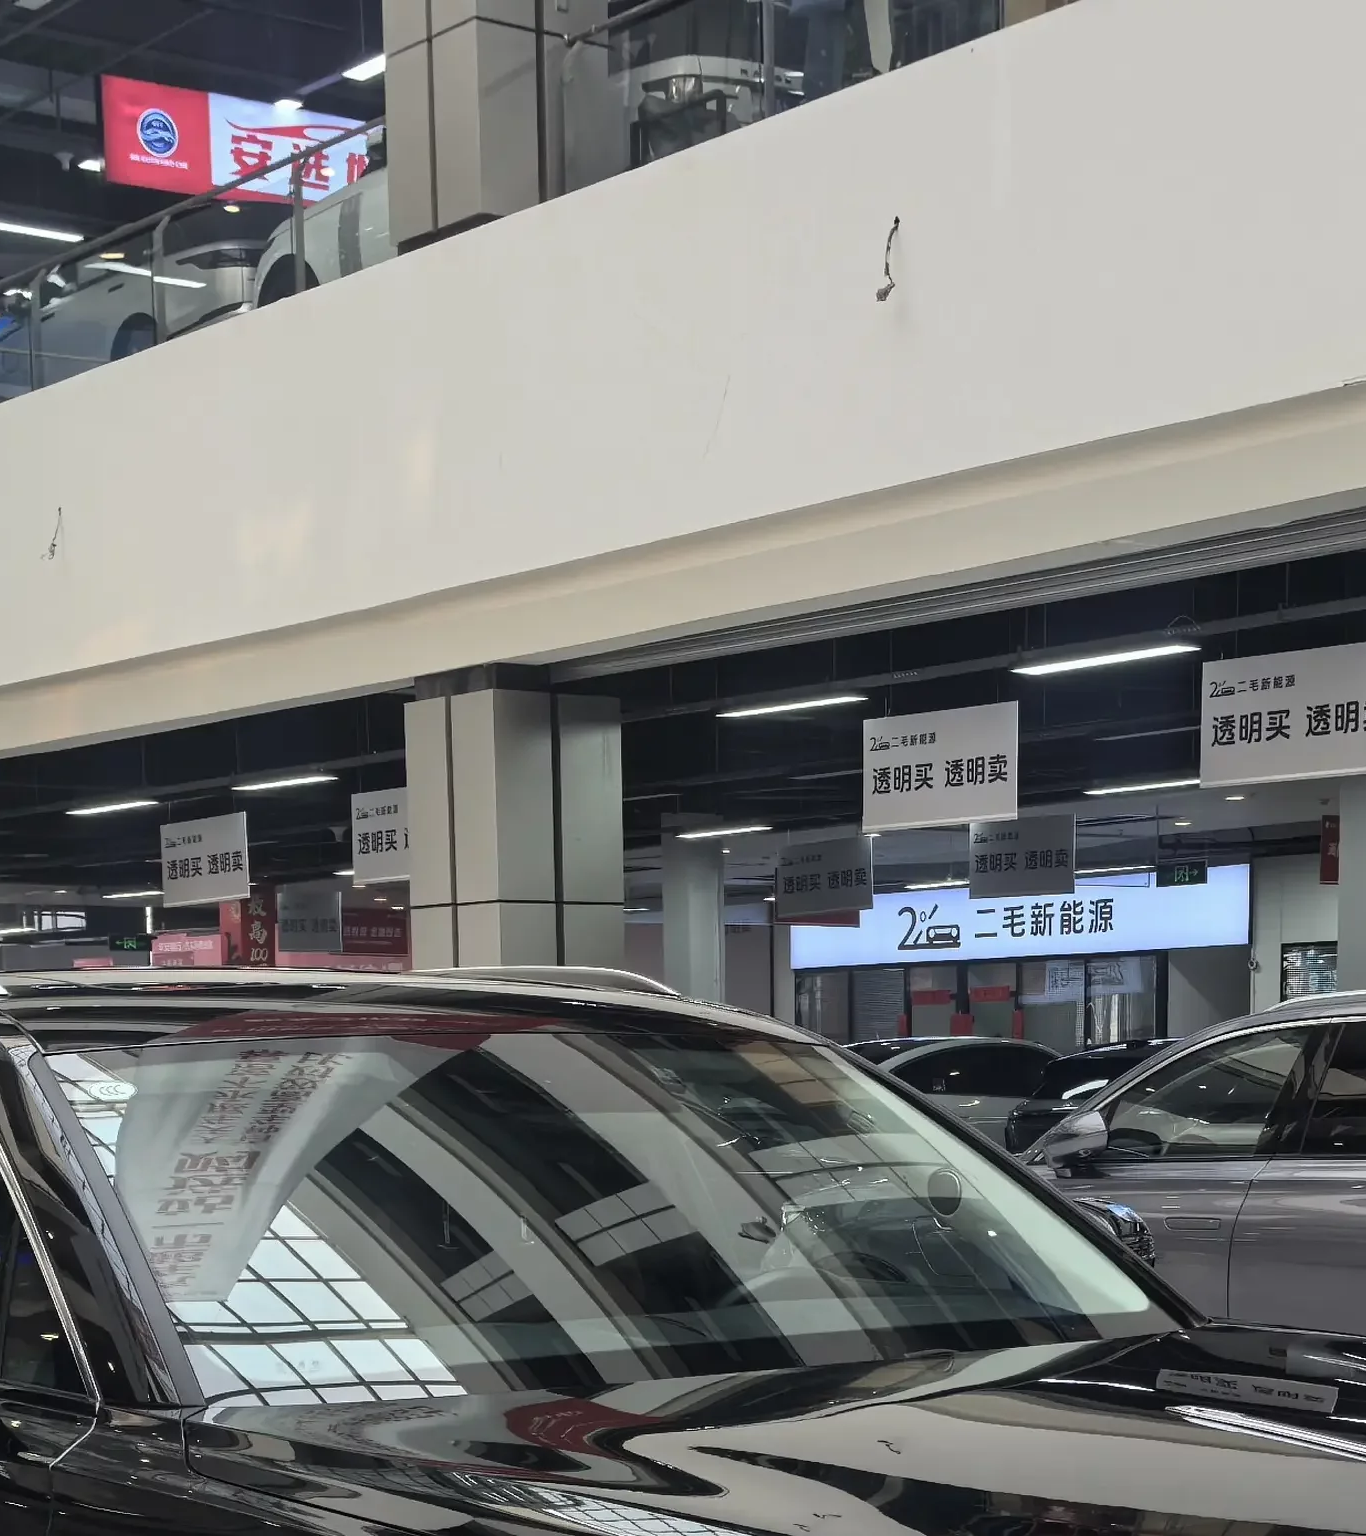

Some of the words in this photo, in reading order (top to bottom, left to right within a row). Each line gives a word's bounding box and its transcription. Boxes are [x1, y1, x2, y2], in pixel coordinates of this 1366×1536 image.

[1211, 709, 1291, 747] 透明买
[872, 762, 934, 795] 透明买
[945, 754, 1008, 788] 透明卖
[358, 828, 398, 855] 透明买
[167, 857, 203, 880] 透明买
[207, 850, 244, 875] 透明卖
[975, 852, 1017, 874] 透明买
[1024, 849, 1069, 870] 透明卖
[783, 873, 822, 894] 透明买
[974, 898, 1114, 939] 二毛新能源
